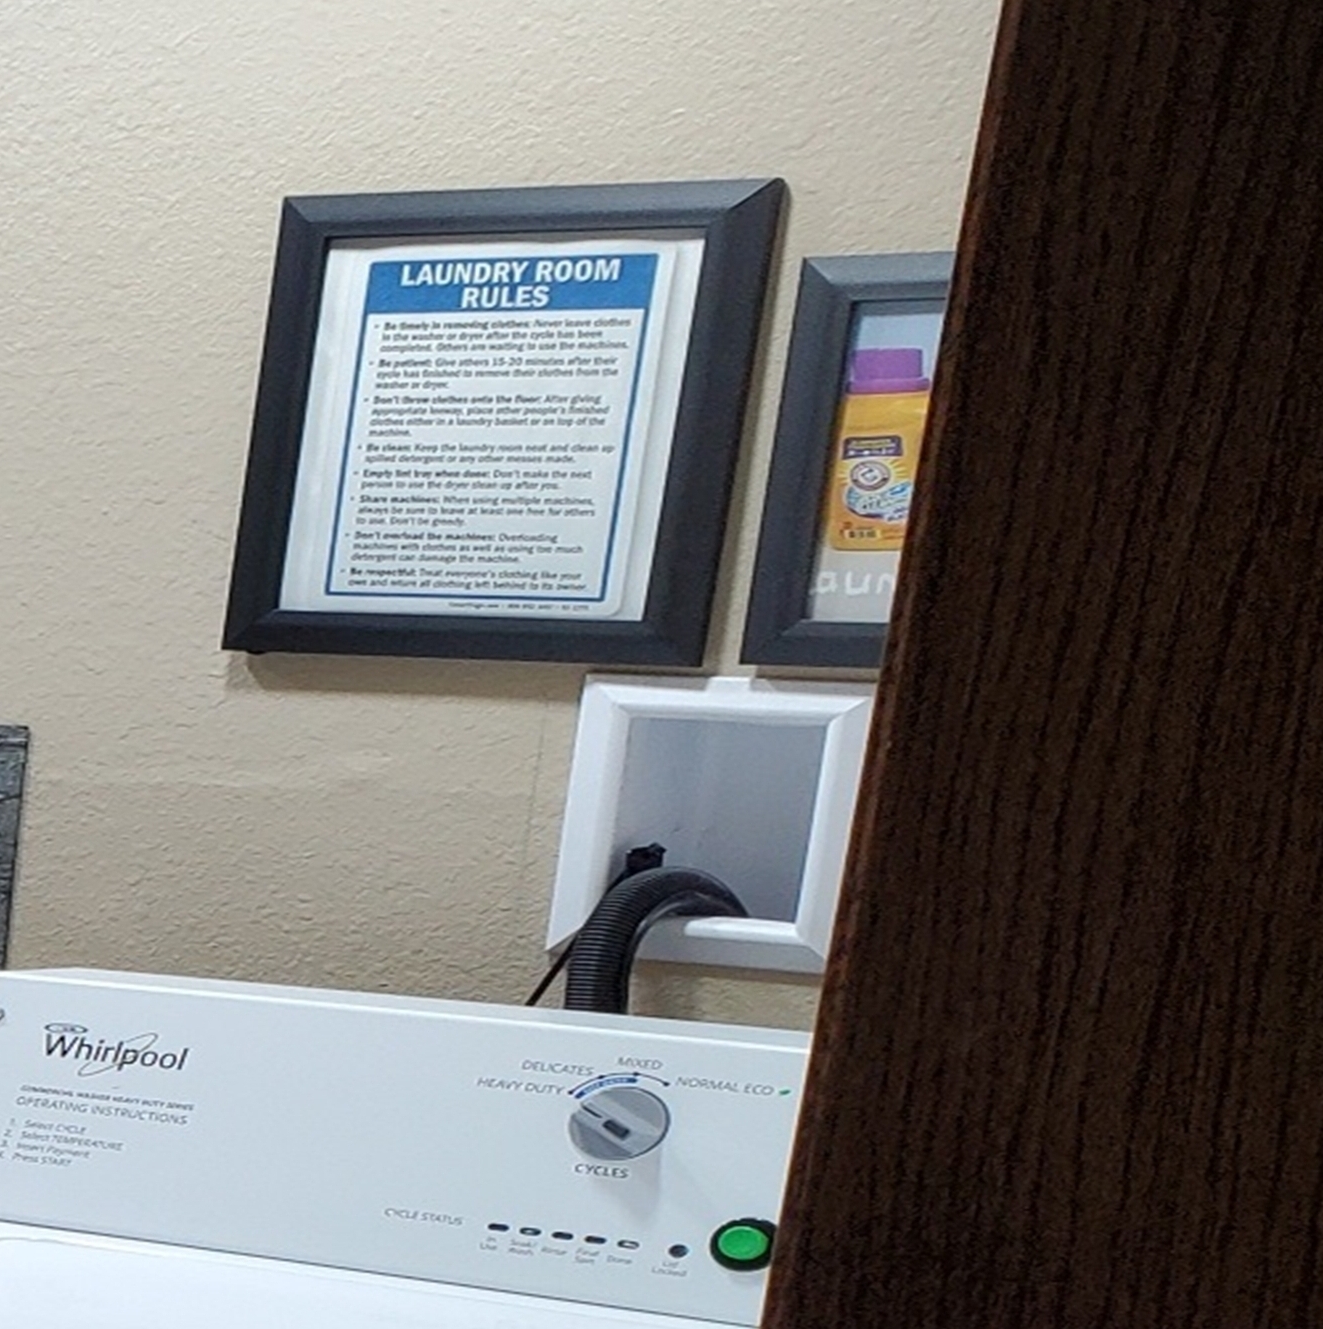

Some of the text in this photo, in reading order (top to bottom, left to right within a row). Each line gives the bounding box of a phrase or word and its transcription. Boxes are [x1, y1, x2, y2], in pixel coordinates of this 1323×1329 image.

[401, 258, 622, 286] LAUNDRY ROOM
[461, 286, 550, 309] RULES
[44, 1033, 189, 1071] Whirlpool
[522, 1059, 595, 1076] DELICATES
[617, 1057, 662, 1070] MIXED
[476, 1077, 522, 1090] HEAVY
[524, 1082, 566, 1095] DUTY
[675, 1077, 774, 1096] NORMAL ECO
[16, 1096, 187, 1125] OPERATING INSTRUCTIONS
[53, 1135, 123, 1151] TEMPERATURE
[41, 1156, 71, 1166] START
[46, 1146, 89, 1159] Payment
[575, 1163, 629, 1178] CYCLES
[384, 1208, 463, 1226] CYCLE STATUS
